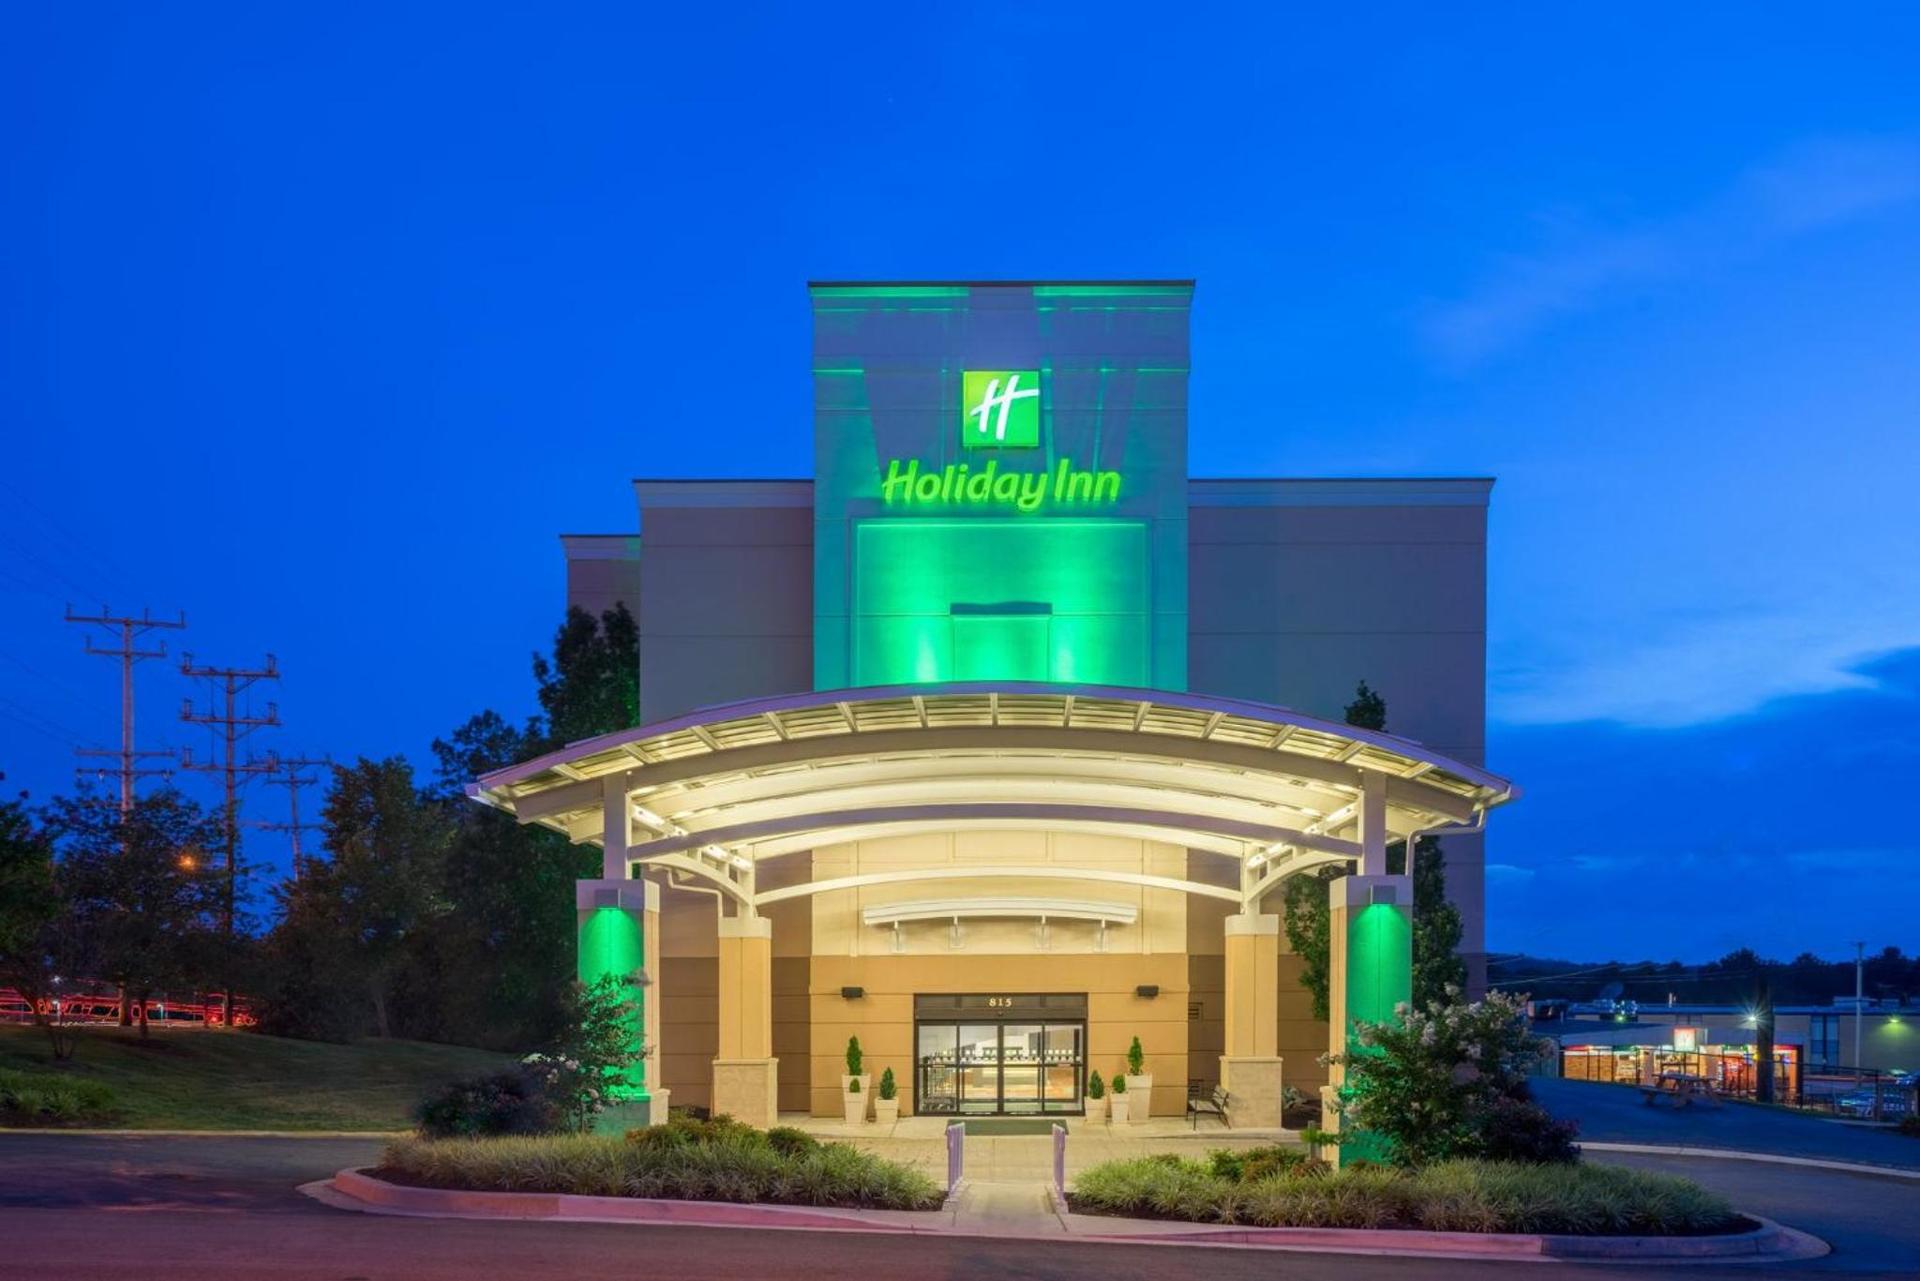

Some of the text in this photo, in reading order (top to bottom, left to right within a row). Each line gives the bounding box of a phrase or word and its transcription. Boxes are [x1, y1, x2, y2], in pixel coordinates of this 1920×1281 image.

[970, 374, 1040, 440] H
[881, 458, 1121, 512] Holiday Inn
[989, 998, 1012, 1007] 815
